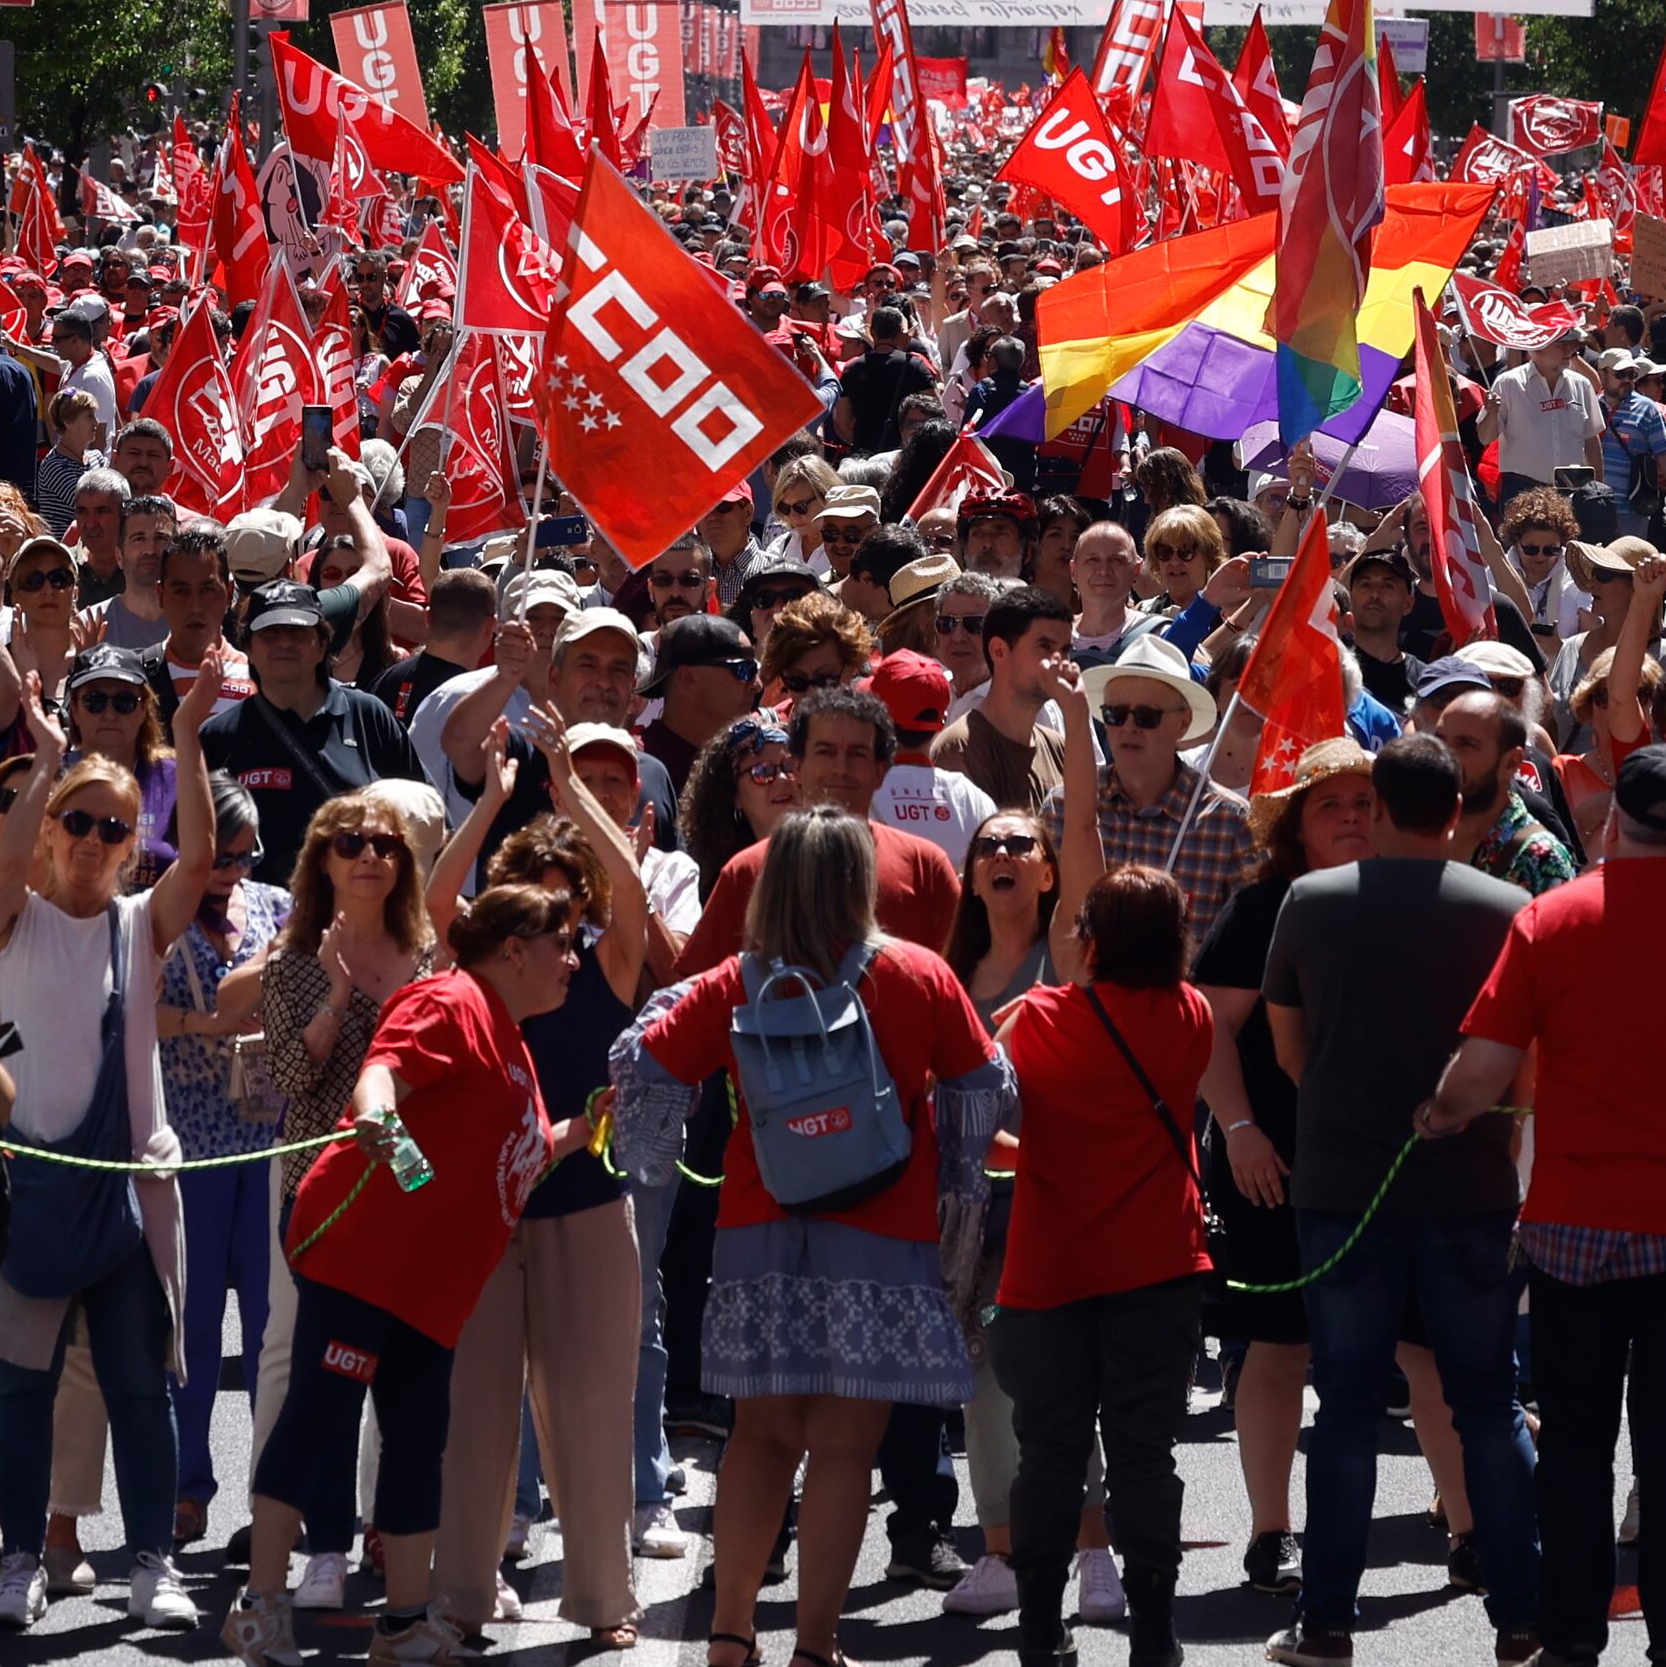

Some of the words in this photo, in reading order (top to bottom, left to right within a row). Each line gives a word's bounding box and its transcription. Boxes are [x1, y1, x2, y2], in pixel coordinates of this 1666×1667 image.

[624, 0, 660, 120] UGT
[1033, 106, 1122, 206] UG
[238, 771, 275, 786] UGT
[894, 805, 930, 821] UGT
[788, 1113, 829, 1136] UGT
[324, 1343, 369, 1376] UGT
